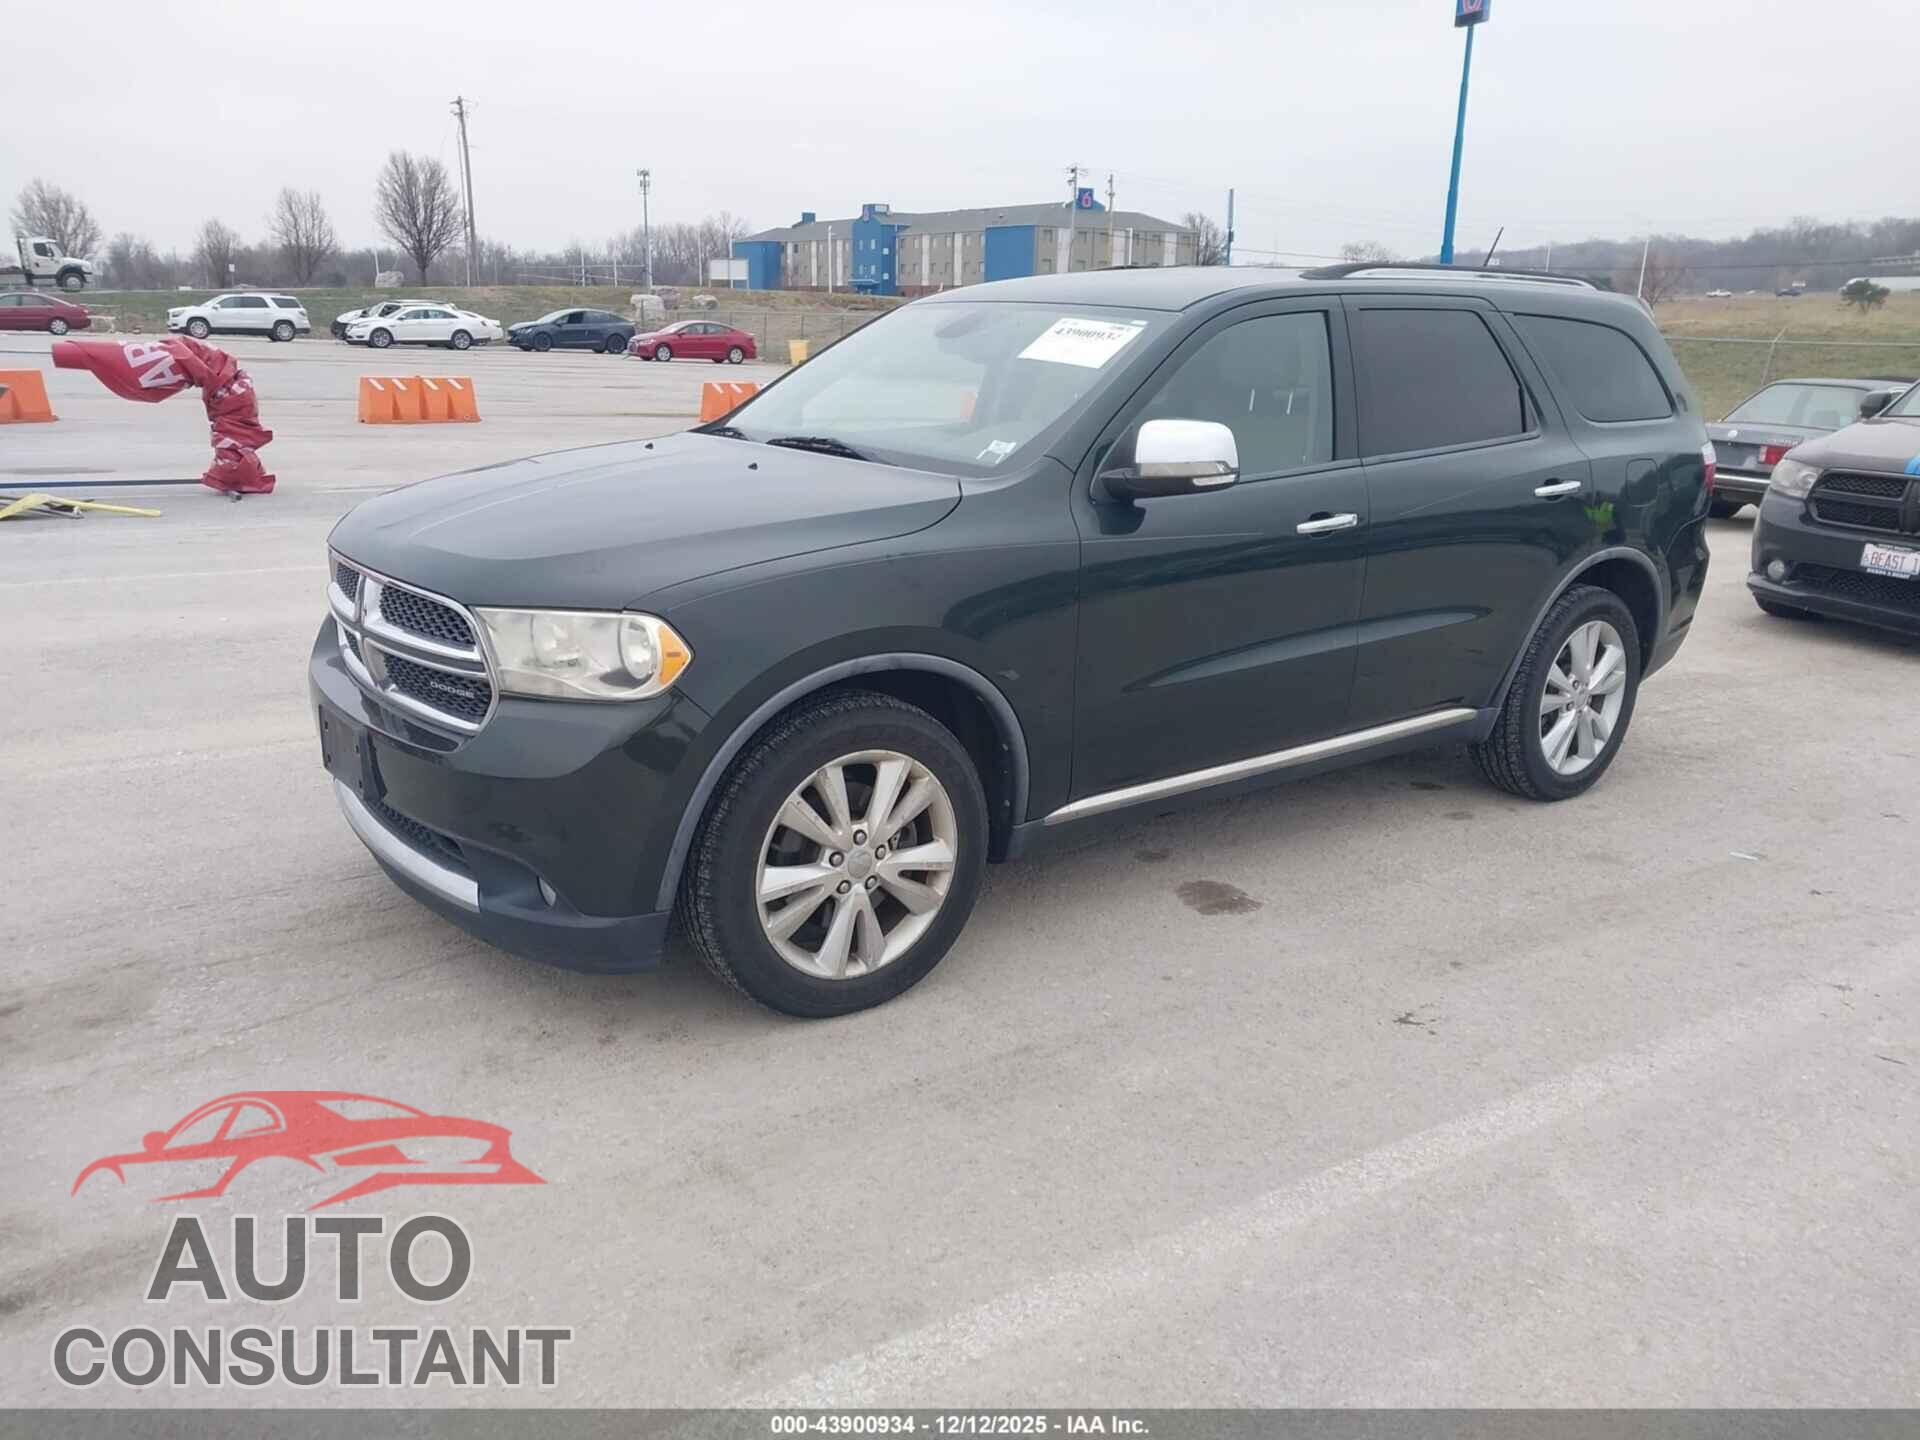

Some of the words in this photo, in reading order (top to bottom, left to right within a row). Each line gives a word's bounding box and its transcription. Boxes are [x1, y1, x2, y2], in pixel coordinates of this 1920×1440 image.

[1082, 191, 1092, 209] 6
[1871, 551, 1905, 571] BEAST
[430, 681, 475, 699] DODGE
